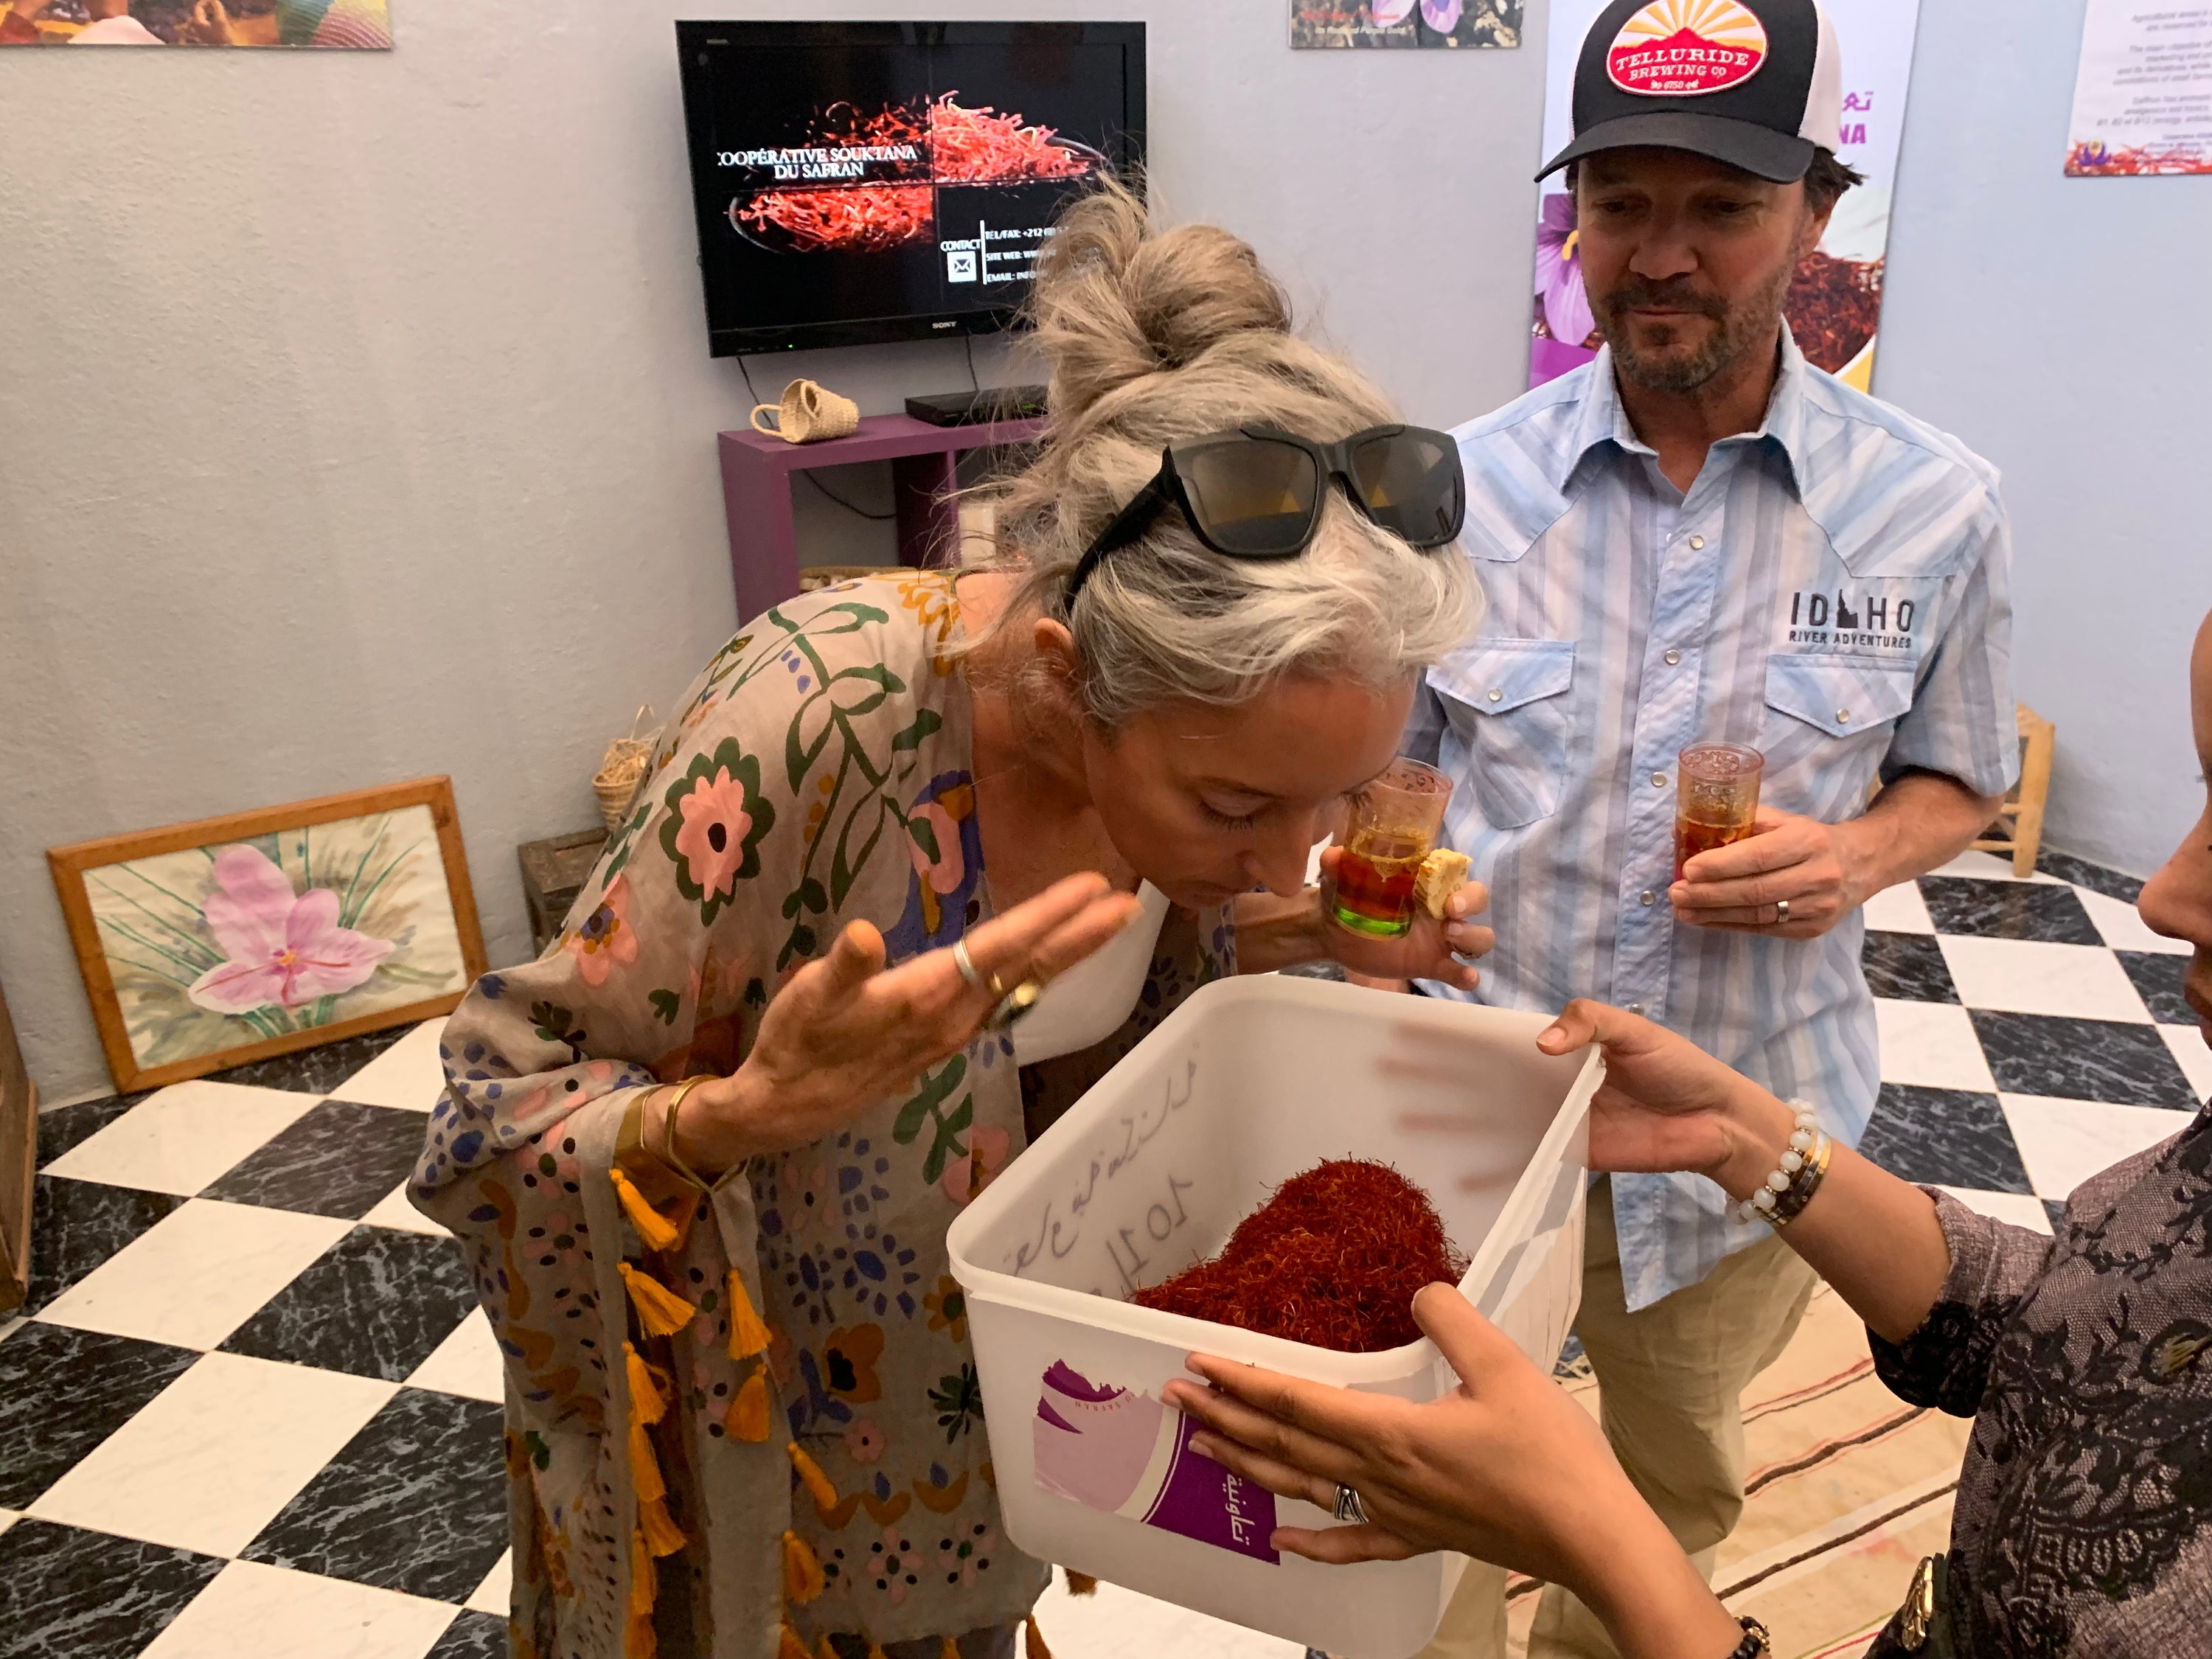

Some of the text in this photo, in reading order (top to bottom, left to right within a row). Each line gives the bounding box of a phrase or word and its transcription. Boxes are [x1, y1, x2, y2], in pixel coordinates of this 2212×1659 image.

[1616, 49, 1749, 71] TELLURIDE
[1629, 64, 1707, 81] BREWING
[1663, 80, 1684, 89] 8750
[830, 145, 917, 162] SOUKTANA
[774, 162, 865, 179] DU SAFRAN
[940, 239, 982, 252] CONTACT
[1790, 630, 1912, 649] RIVER ADVENTURES
[1222, 1473, 1256, 1546] تعاونية
